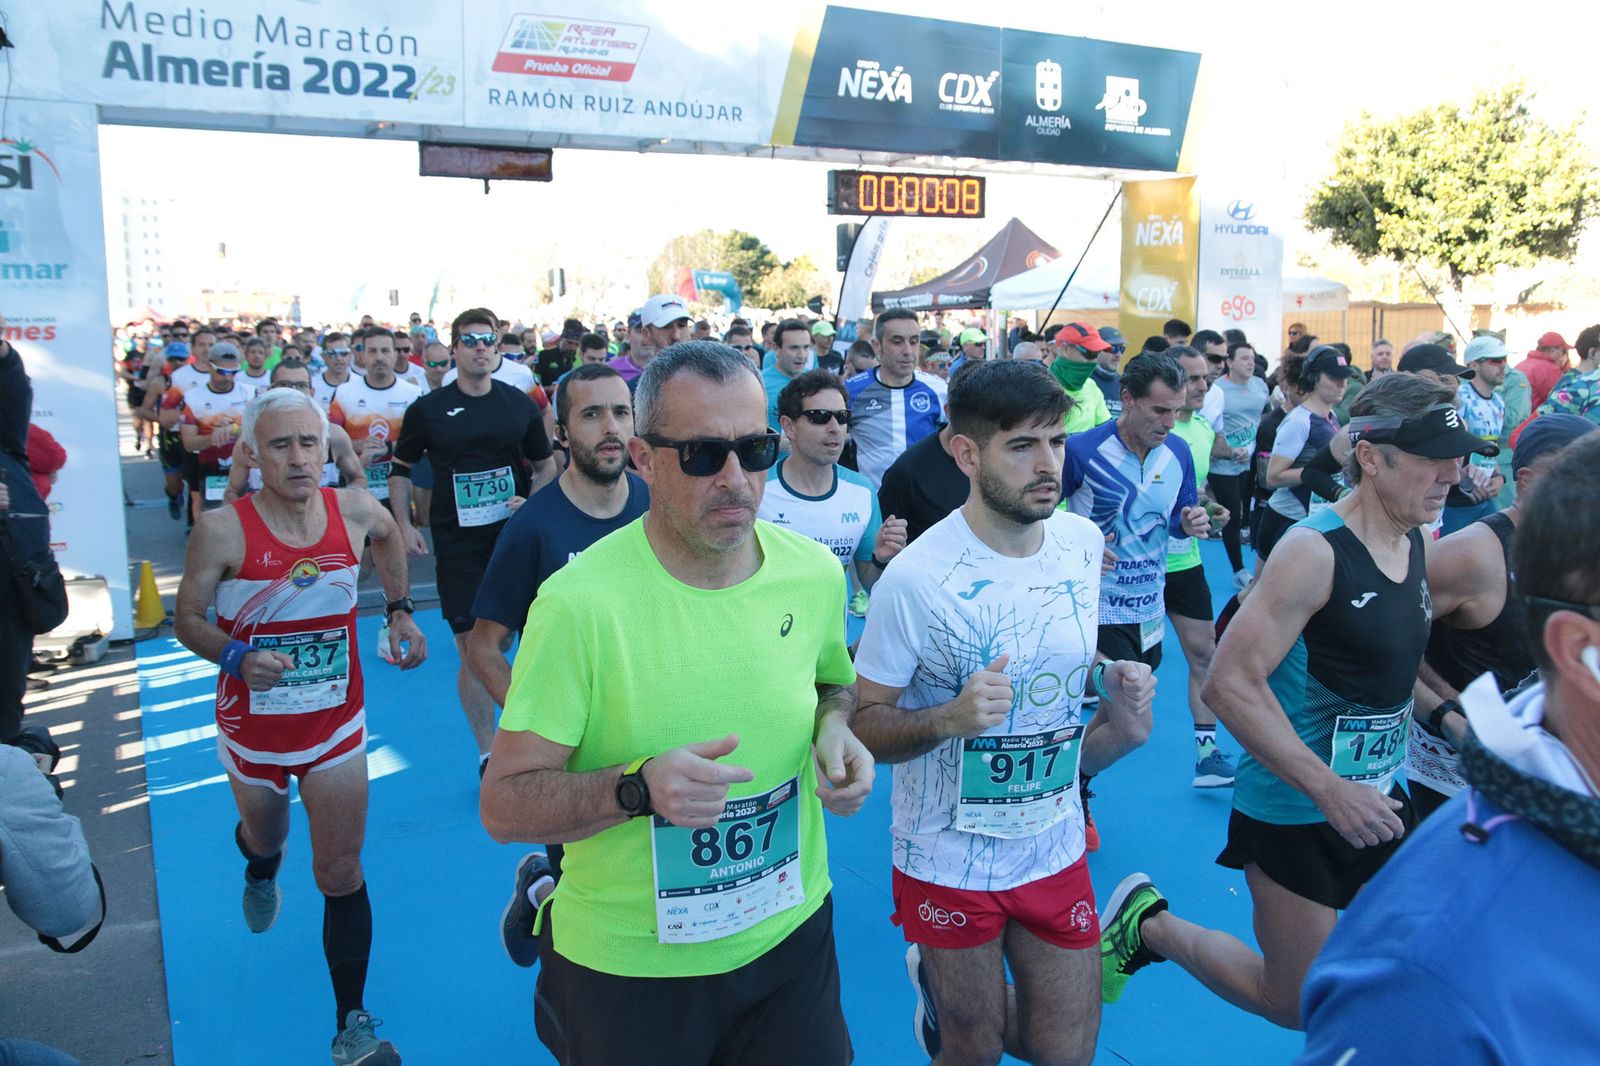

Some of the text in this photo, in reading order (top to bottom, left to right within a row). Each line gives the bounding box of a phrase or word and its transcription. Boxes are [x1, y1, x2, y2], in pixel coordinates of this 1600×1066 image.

[101, 0, 417, 56] Medio Maratón
[102, 40, 290, 91] Almería
[524, 60, 613, 77] Prueba Oficial
[838, 66, 912, 104] NEXA
[938, 71, 1000, 107] CDX
[488, 88, 743, 122] RAMÓN RUIZ ANDÚJAR
[1025, 114, 1071, 129] ALMERÍA
[1036, 127, 1061, 137] CIUDAD
[1135, 219, 1184, 247] NEXA
[1214, 223, 1269, 236] HYUNDAI
[1, 263, 68, 280] mar
[1220, 268, 1260, 276] ESTRELLA
[1135, 281, 1180, 312] CDX
[1221, 295, 1256, 321] ego
[463, 478, 509, 498] 1730
[815, 537, 853, 546] Maratón
[831, 546, 852, 556] 022
[271, 643, 339, 670] 437
[302, 667, 333, 677] CARLOS
[989, 745, 1060, 784] 917
[1007, 782, 1041, 793] FELIPE
[719, 806, 757, 819] ería 2022
[727, 801, 758, 810] Maratón
[690, 810, 780, 868] 867
[709, 855, 765, 879] ANTONIO
[667, 906, 688, 916] NEXA
[704, 902, 720, 911] CDX
